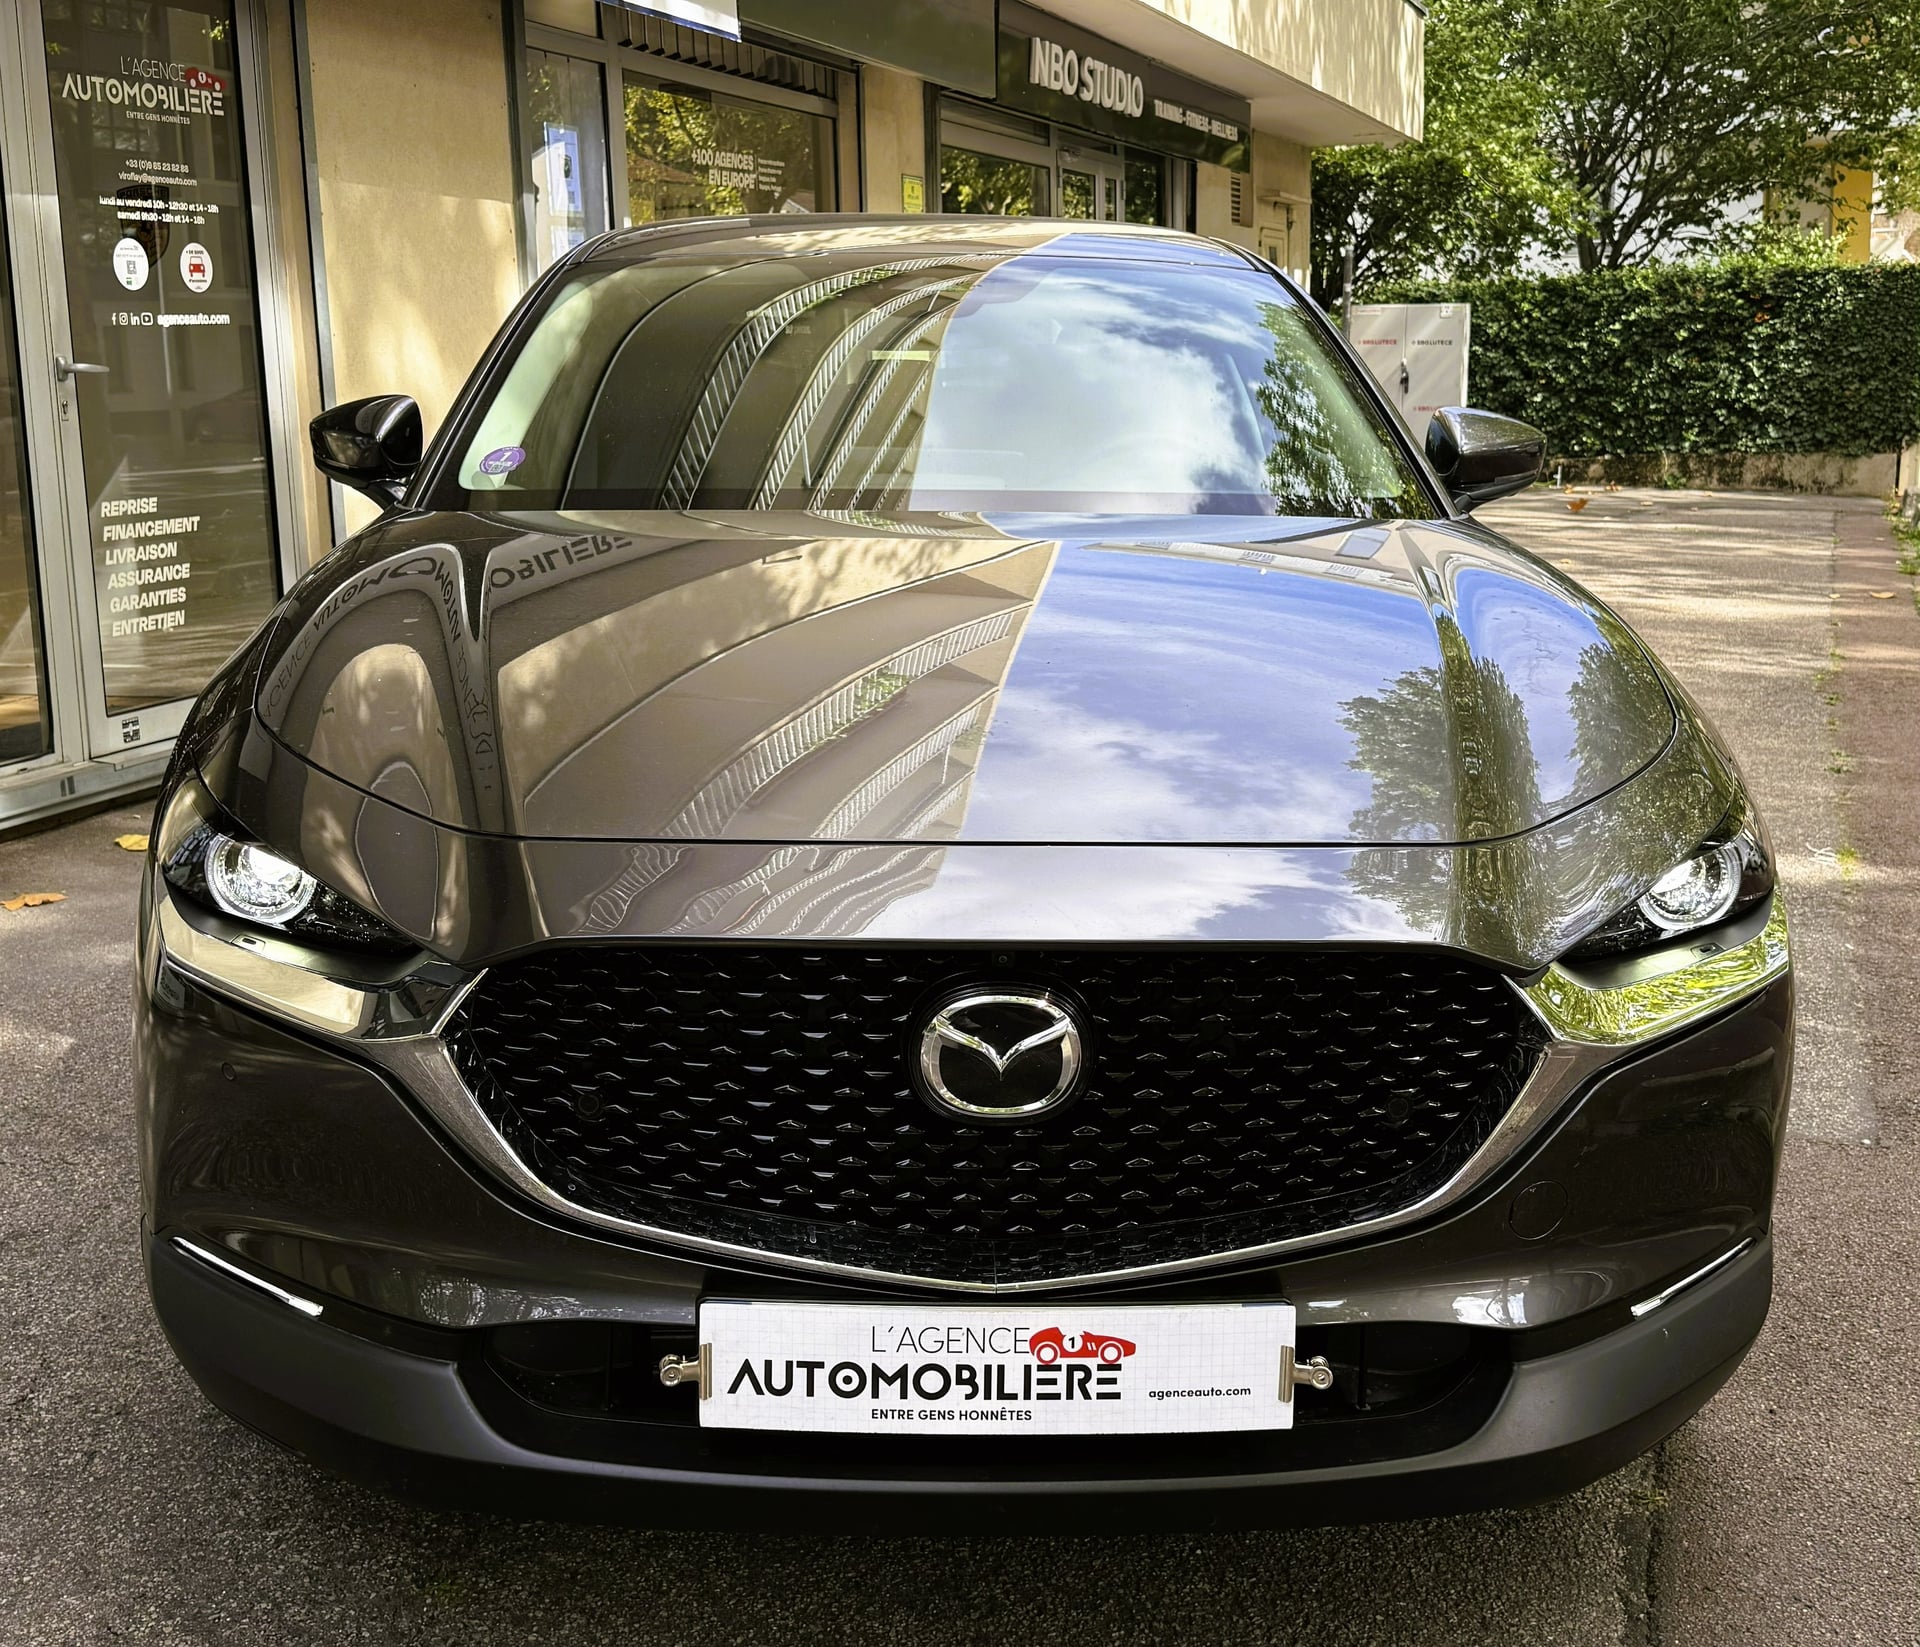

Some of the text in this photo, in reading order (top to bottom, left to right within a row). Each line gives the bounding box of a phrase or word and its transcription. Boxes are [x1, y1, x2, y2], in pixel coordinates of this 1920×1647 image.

[1029, 36, 1144, 118] NBO STUDIO
[125, 110, 144, 120] ENTRE
[144, 113, 161, 122] GENS
[1185, 110, 1209, 133] FITNESS
[691, 148, 714, 166] +100
[714, 151, 754, 171] AGENCES
[708, 168, 721, 186] EN
[125, 198, 153, 209] vendredi
[117, 210, 141, 220] samedi
[101, 496, 158, 518] REPRISE
[103, 515, 200, 542] FINANCEMENT
[105, 541, 178, 566] LIVRAISON
[107, 562, 191, 590] ASSURANCE
[110, 586, 187, 613] GARANTIES
[112, 609, 185, 637] ENTRETIEN
[1068, 1336, 1076, 1350] 1
[1147, 1386, 1251, 1400] agenceauto.com
[871, 1407, 1032, 1421] ENTRE GENS HONNÊTES
